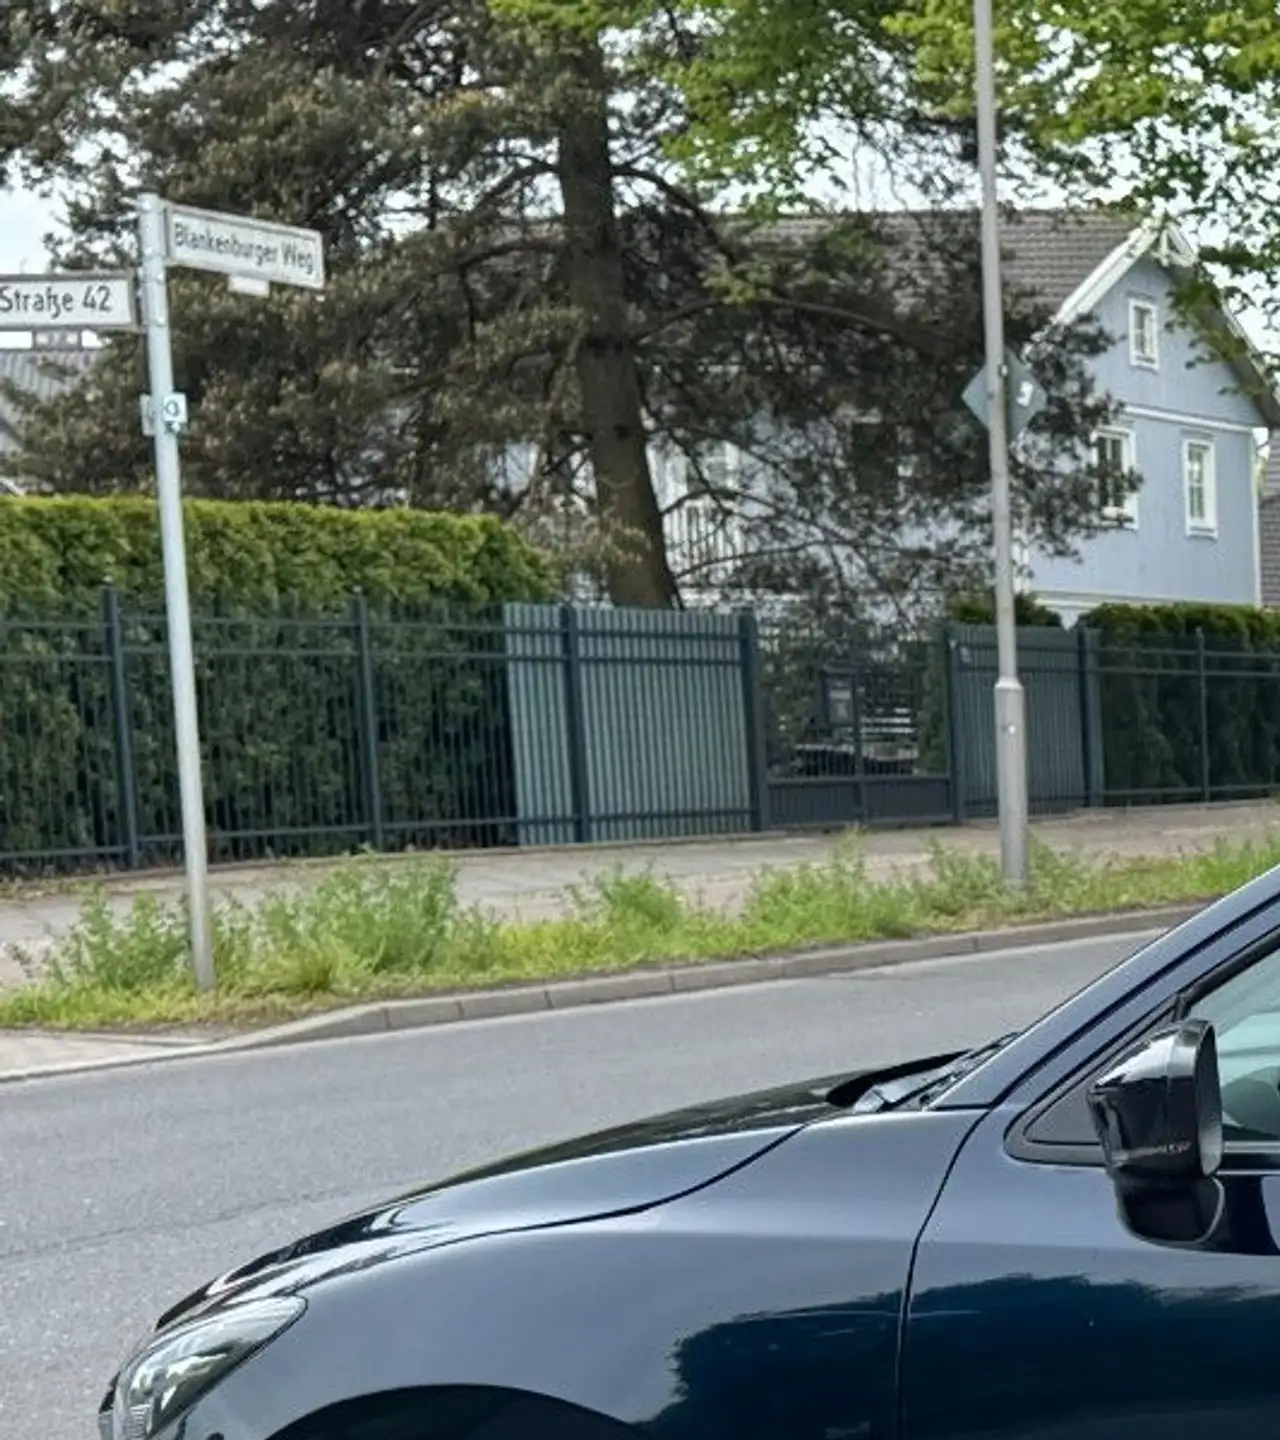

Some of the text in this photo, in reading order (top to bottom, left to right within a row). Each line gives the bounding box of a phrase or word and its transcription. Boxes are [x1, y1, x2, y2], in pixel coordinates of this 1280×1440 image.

[175, 222, 314, 275] Blankenburger Weg
[0, 284, 113, 320] Straße 42
